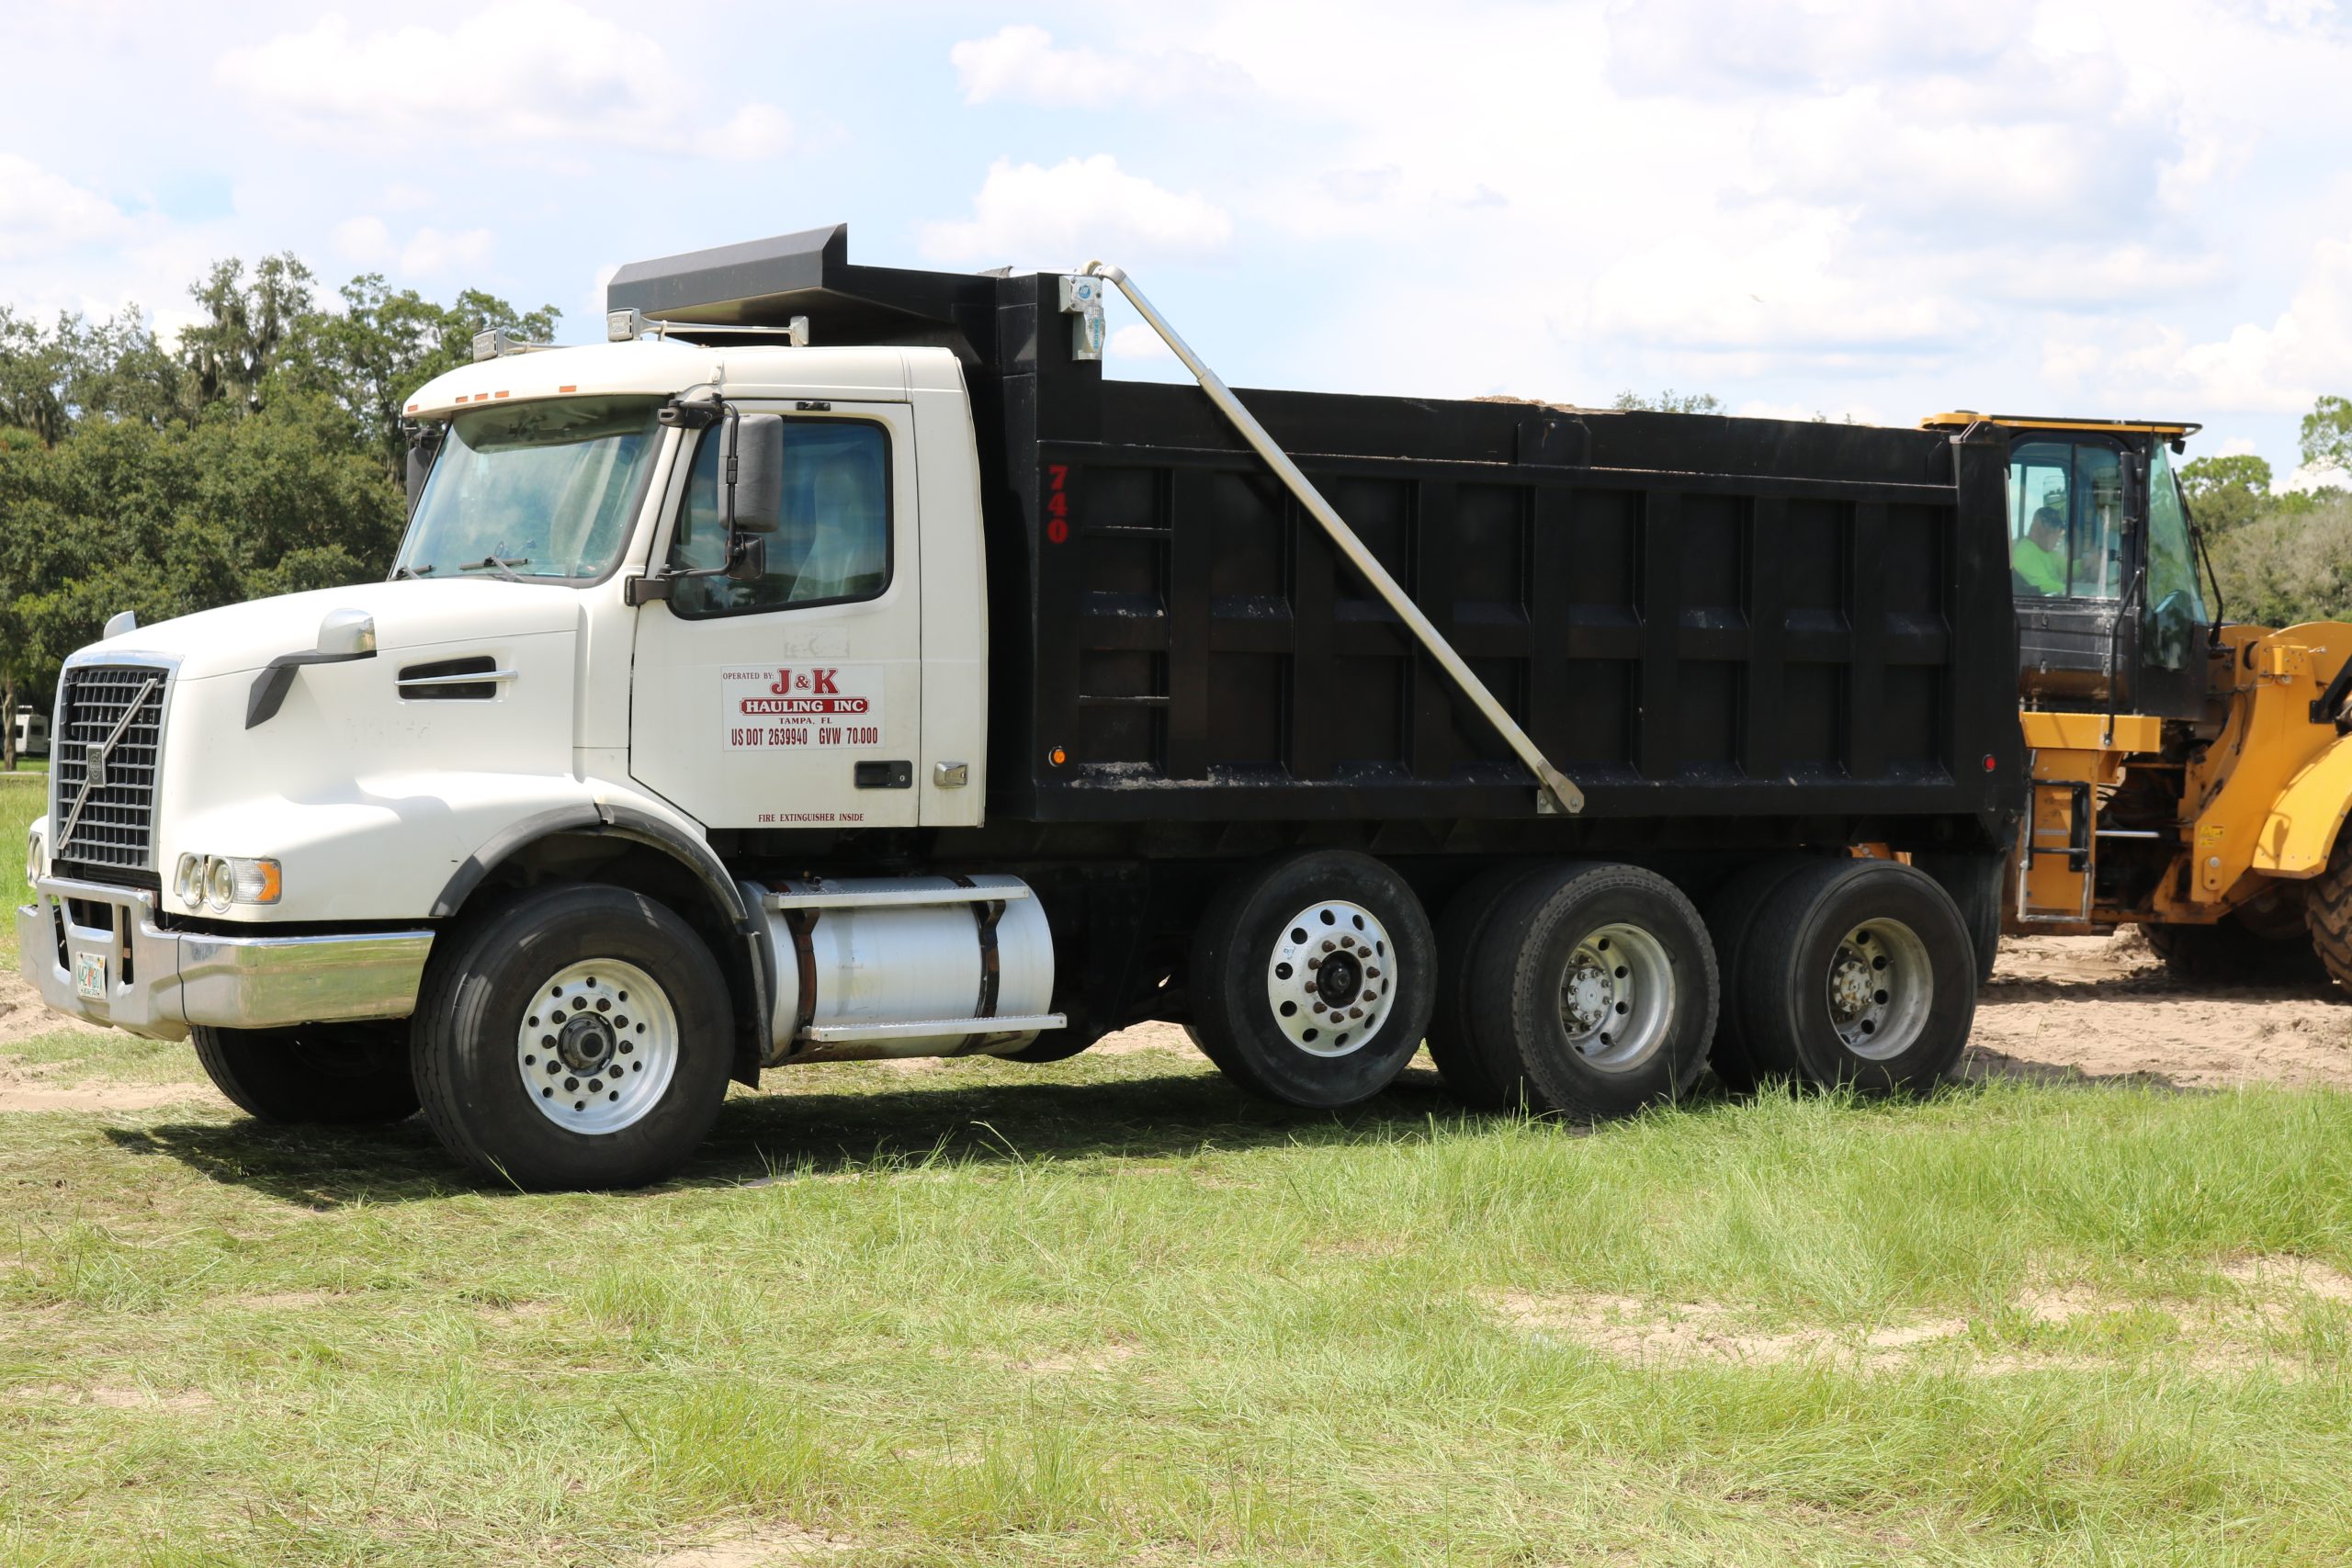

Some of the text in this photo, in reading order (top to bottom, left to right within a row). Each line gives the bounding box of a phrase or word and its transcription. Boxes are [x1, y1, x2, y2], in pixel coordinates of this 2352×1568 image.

[1047, 465, 1069, 544] 740
[745, 700, 865, 713] HAULING INC
[731, 728, 743, 746] US
[746, 728, 764, 746] DOT
[768, 728, 808, 746] 2639940
[819, 728, 842, 745] GVW
[758, 813, 865, 822] FIRE EXTINGUISHER INSIDE
